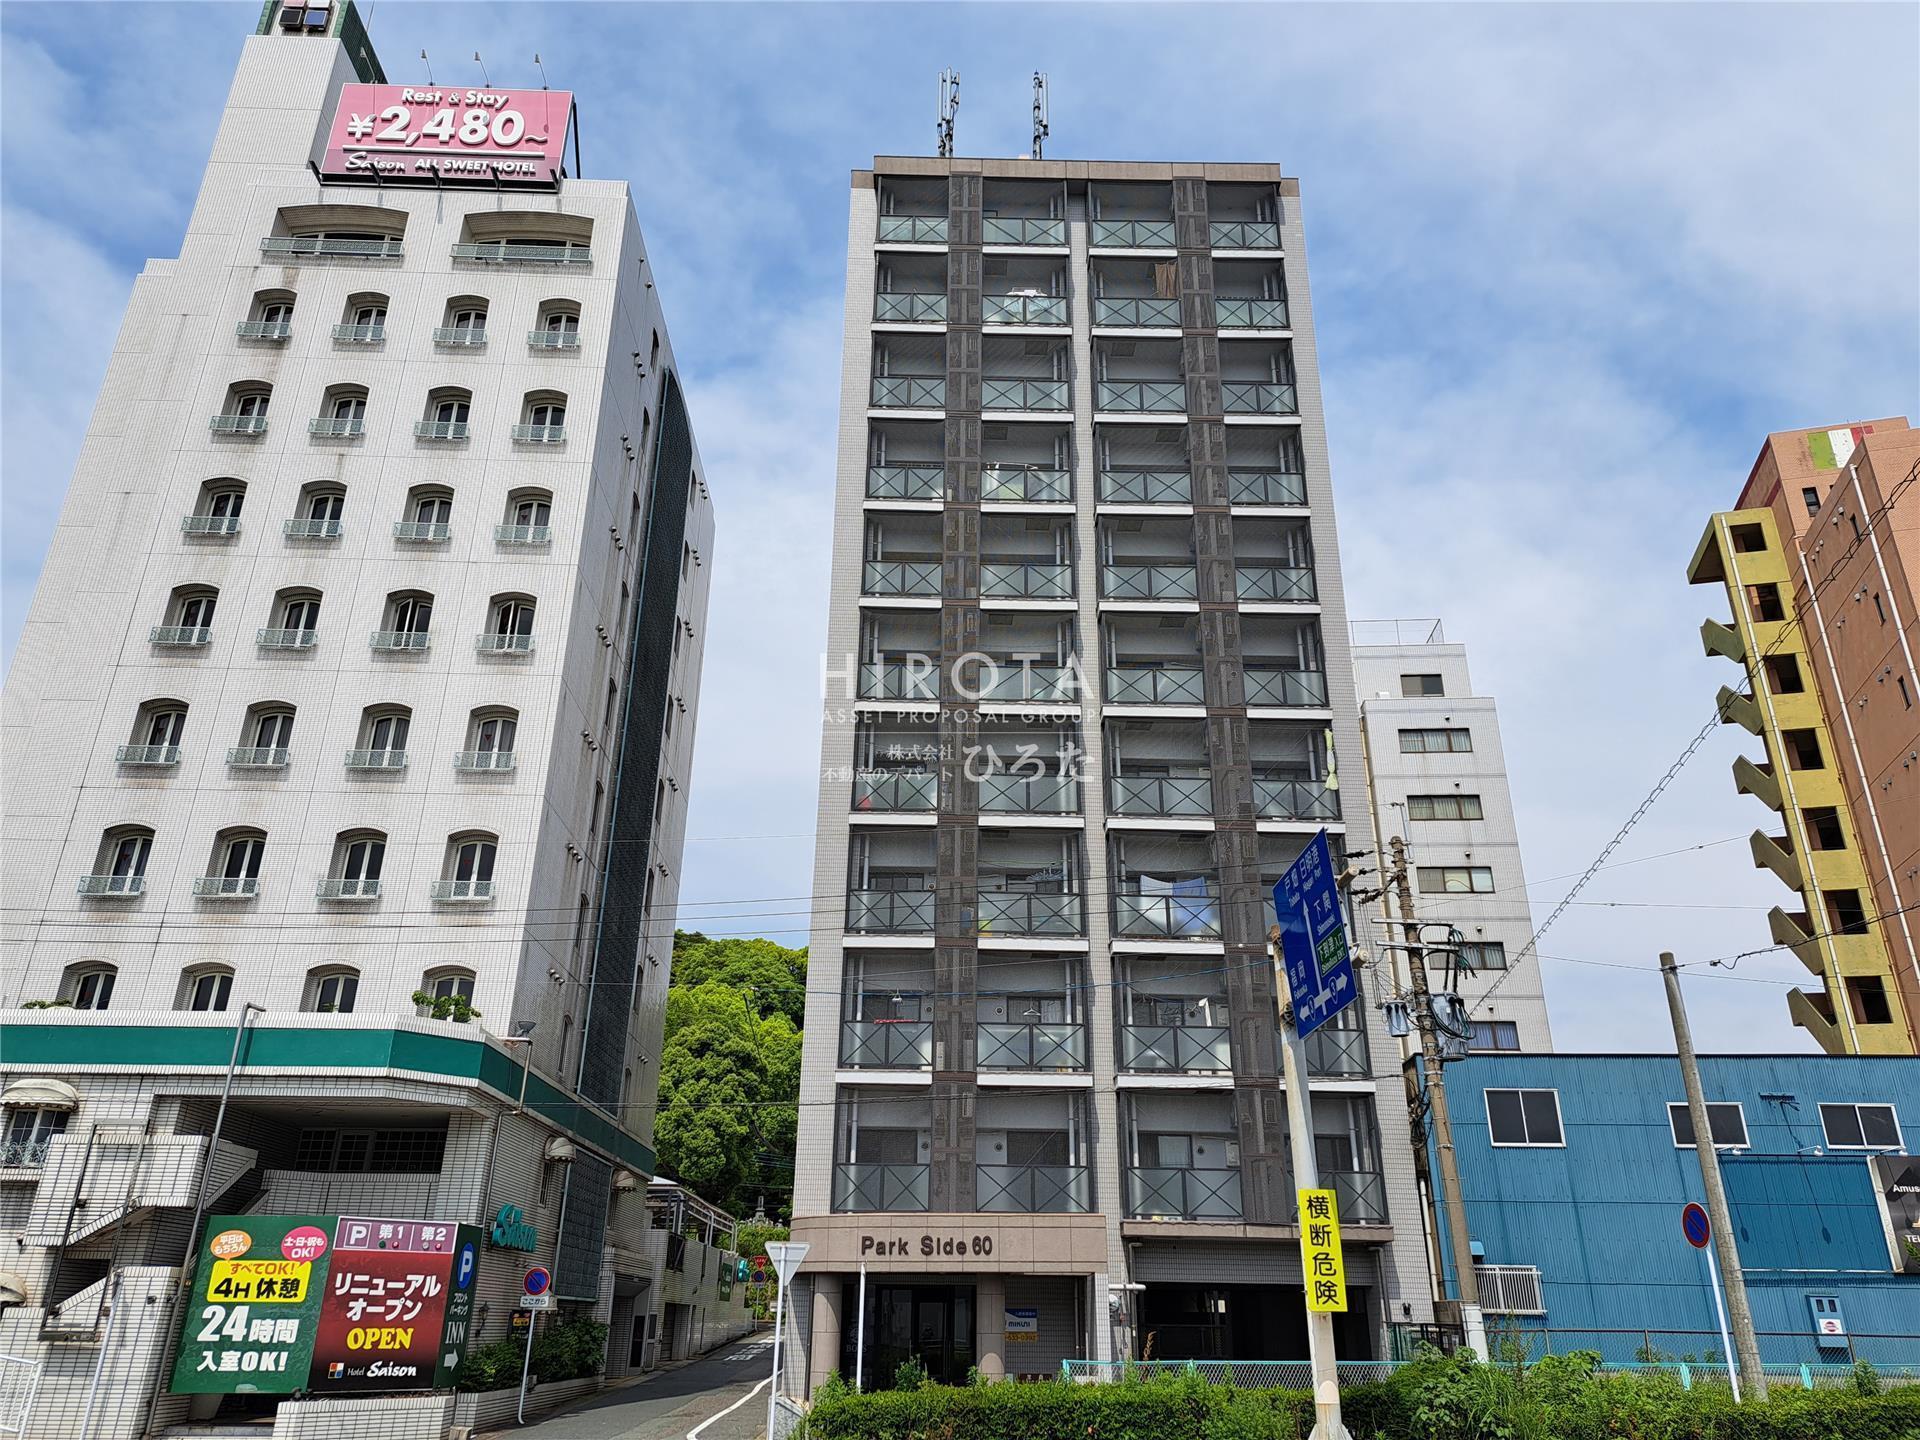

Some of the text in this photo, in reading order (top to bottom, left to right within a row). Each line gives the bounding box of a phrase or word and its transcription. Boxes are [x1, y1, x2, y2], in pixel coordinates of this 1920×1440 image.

[401, 89, 509, 109] Rest & Stay
[345, 152, 536, 173] Saison ALL SWEET HOTEL
[214, 1243, 248, 1255] もちろん
[220, 1234, 244, 1245] 平日は
[861, 1236, 909, 1256] Park
[972, 1236, 993, 1256] 60
[291, 1247, 315, 1259] OK!
[1307, 1195, 1339, 1305] 横断危険
[230, 1262, 295, 1276] すべてOK!
[335, 1272, 442, 1297] リニューアル
[346, 1297, 423, 1321] オープン
[346, 1327, 414, 1350] OPEN
[445, 1321, 466, 1344] INN
[196, 1350, 289, 1372] 入室OK!
[347, 1361, 417, 1378] Hotel Saison
